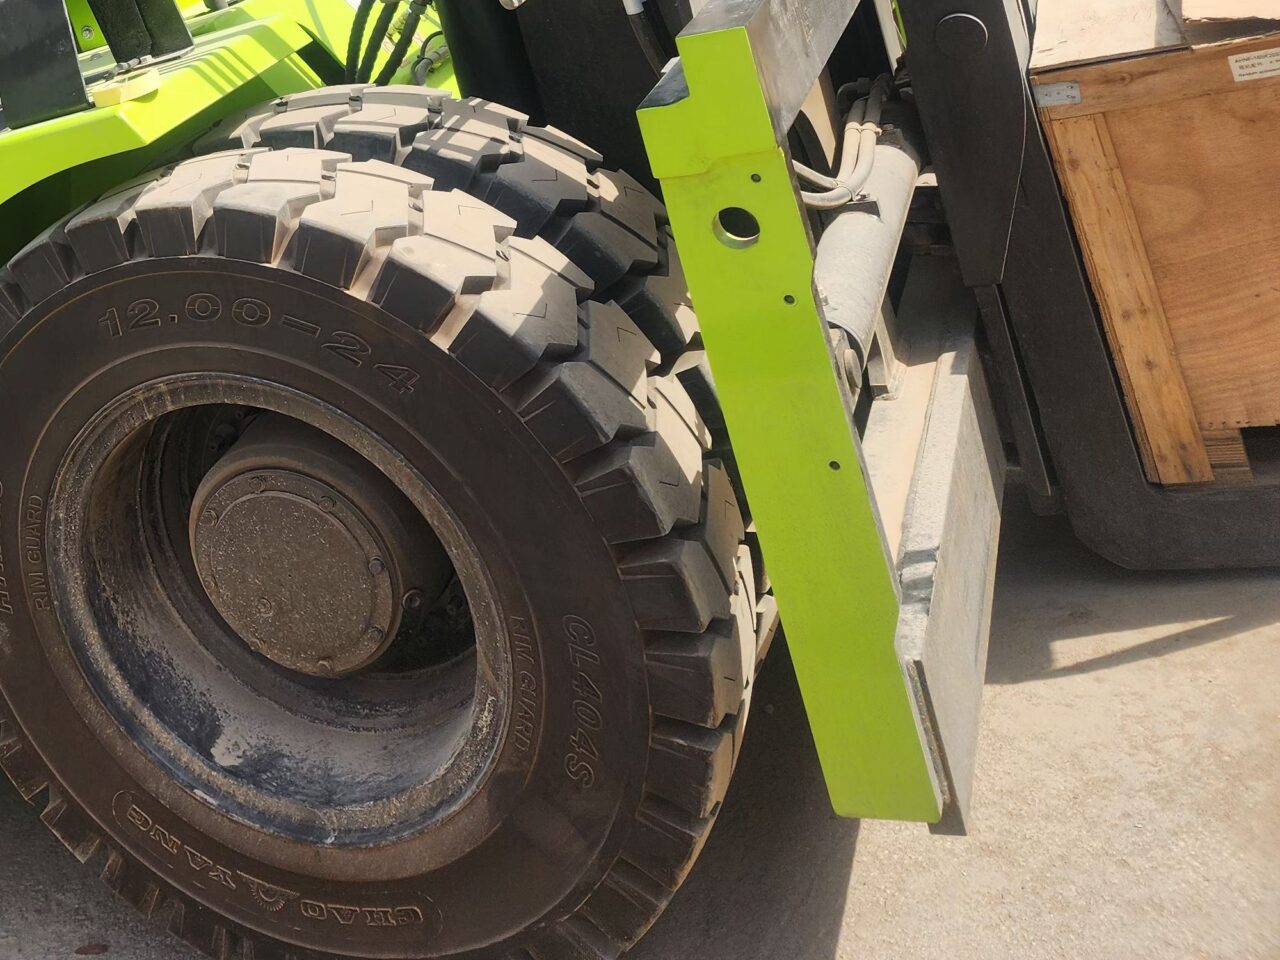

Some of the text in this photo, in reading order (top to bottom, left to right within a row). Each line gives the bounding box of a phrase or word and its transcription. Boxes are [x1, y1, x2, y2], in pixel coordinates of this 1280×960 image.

[98, 293, 420, 394] 12.00-24
[23, 495, 51, 611] RIM GUARD
[562, 614, 603, 789] CL404S
[126, 804, 424, 926] CHAO YANG
